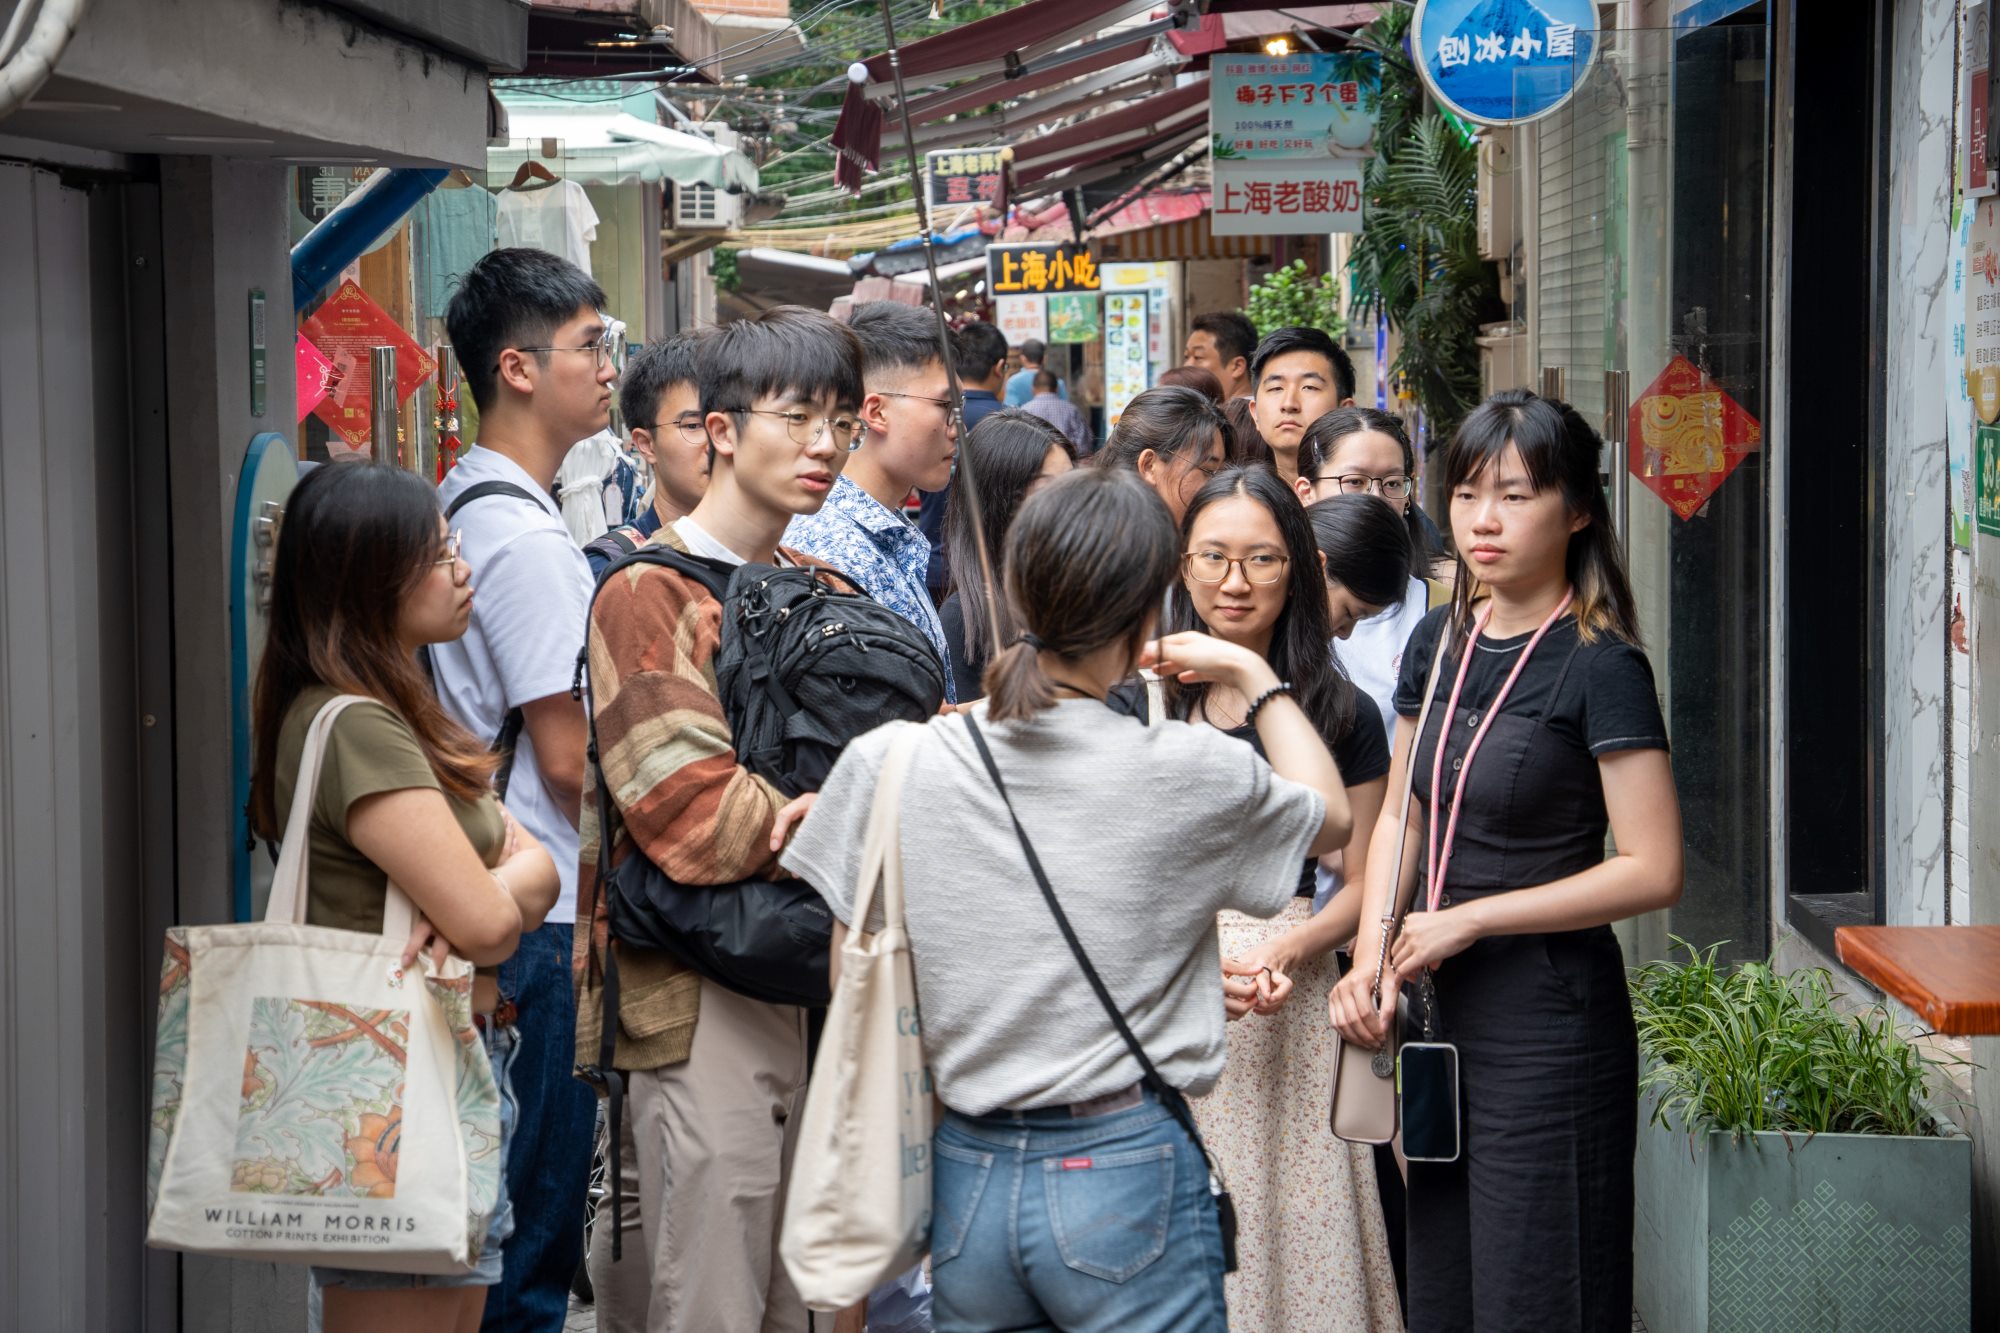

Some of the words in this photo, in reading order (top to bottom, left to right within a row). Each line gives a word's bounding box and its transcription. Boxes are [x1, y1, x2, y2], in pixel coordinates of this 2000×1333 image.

[1437, 24, 1577, 68] 刨冰小屋
[1236, 82, 1360, 105] 椰子下了个蛋
[1235, 120, 1294, 131] 100%纯天然
[1215, 180, 1361, 215] 上海老酸奶
[994, 249, 1100, 291] 上海小吃
[205, 1208, 303, 1228] WILLIAM
[325, 1215, 416, 1232] MORRIS
[225, 1227, 273, 1240] COTTON
[276, 1231, 318, 1243] PRINTS
[322, 1233, 390, 1245] EXHIBITION
